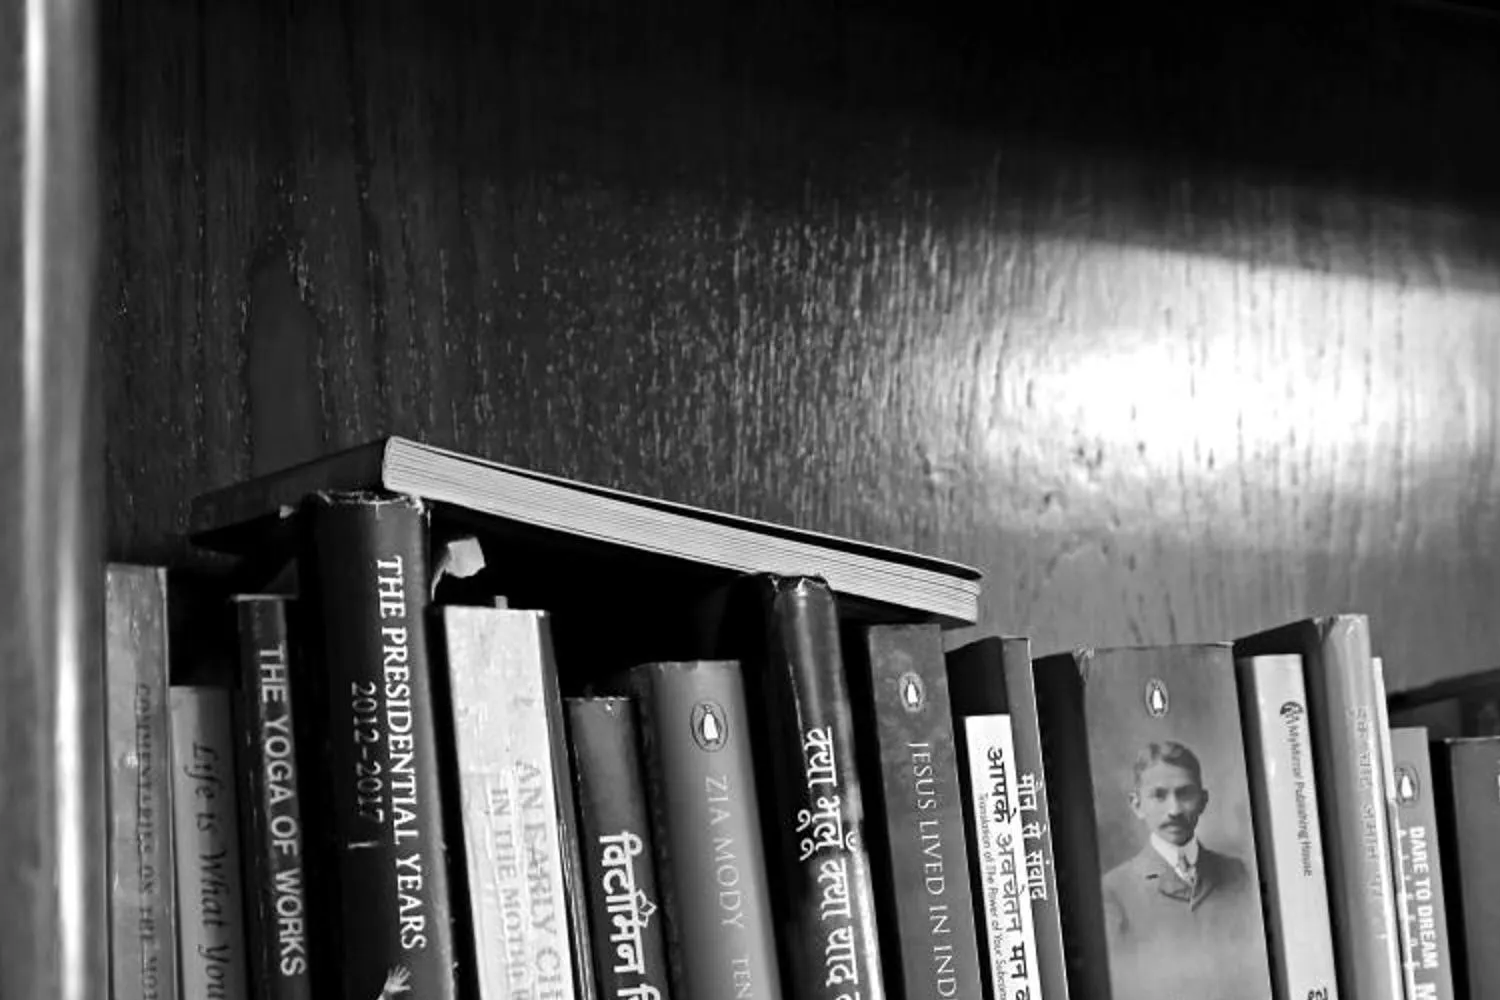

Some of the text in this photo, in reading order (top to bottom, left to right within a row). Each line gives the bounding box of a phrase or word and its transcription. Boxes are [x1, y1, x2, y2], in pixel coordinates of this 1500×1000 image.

[185, 743, 219, 800] Life
[350, 681, 386, 825] 2012-2017
[376, 555, 427, 951] THE PRESIDENTIAL YEARS
[802, 725, 839, 790] क्या
[907, 742, 940, 813] JESUS
[985, 745, 1018, 825] आपके
[259, 645, 308, 978] THE YOGA OF WORKS
[490, 787, 512, 819] IN
[514, 758, 545, 816] AN
[198, 808, 214, 833] is
[703, 774, 749, 931] ZIA MODY
[796, 794, 861, 863] भूलूँ
[1408, 826, 1428, 876] DARE
[199, 848, 229, 926] What
[494, 827, 517, 885] THE
[523, 823, 557, 941] EARLY
[917, 818, 948, 897] LIVED
[996, 832, 1026, 934] अवचेतन
[1025, 849, 1051, 901] संवाद
[599, 831, 646, 975] विटामिन
[817, 856, 852, 922] क्या
[928, 904, 952, 937] IN
[1414, 880, 1431, 903] TO
[825, 924, 859, 988] याद
[1010, 941, 1029, 980] मन
[1416, 905, 1440, 970] DREAM
[198, 944, 231, 1000] You
[732, 955, 756, 1000] TEN
